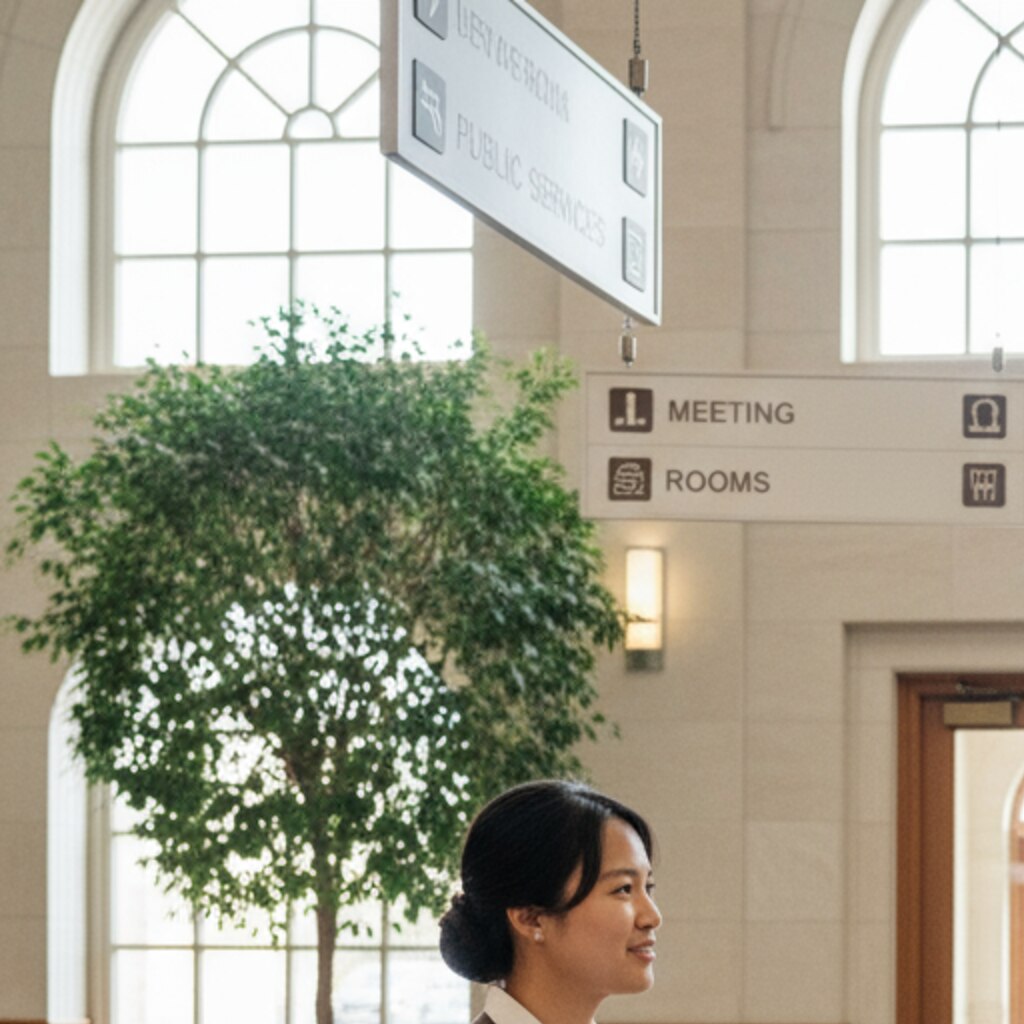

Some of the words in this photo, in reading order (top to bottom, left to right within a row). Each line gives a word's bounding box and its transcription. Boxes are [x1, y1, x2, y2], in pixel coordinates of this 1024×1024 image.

[457, 113, 522, 190] PUBLIC
[668, 400, 794, 424] MEETING
[666, 470, 770, 493] ROOMS
